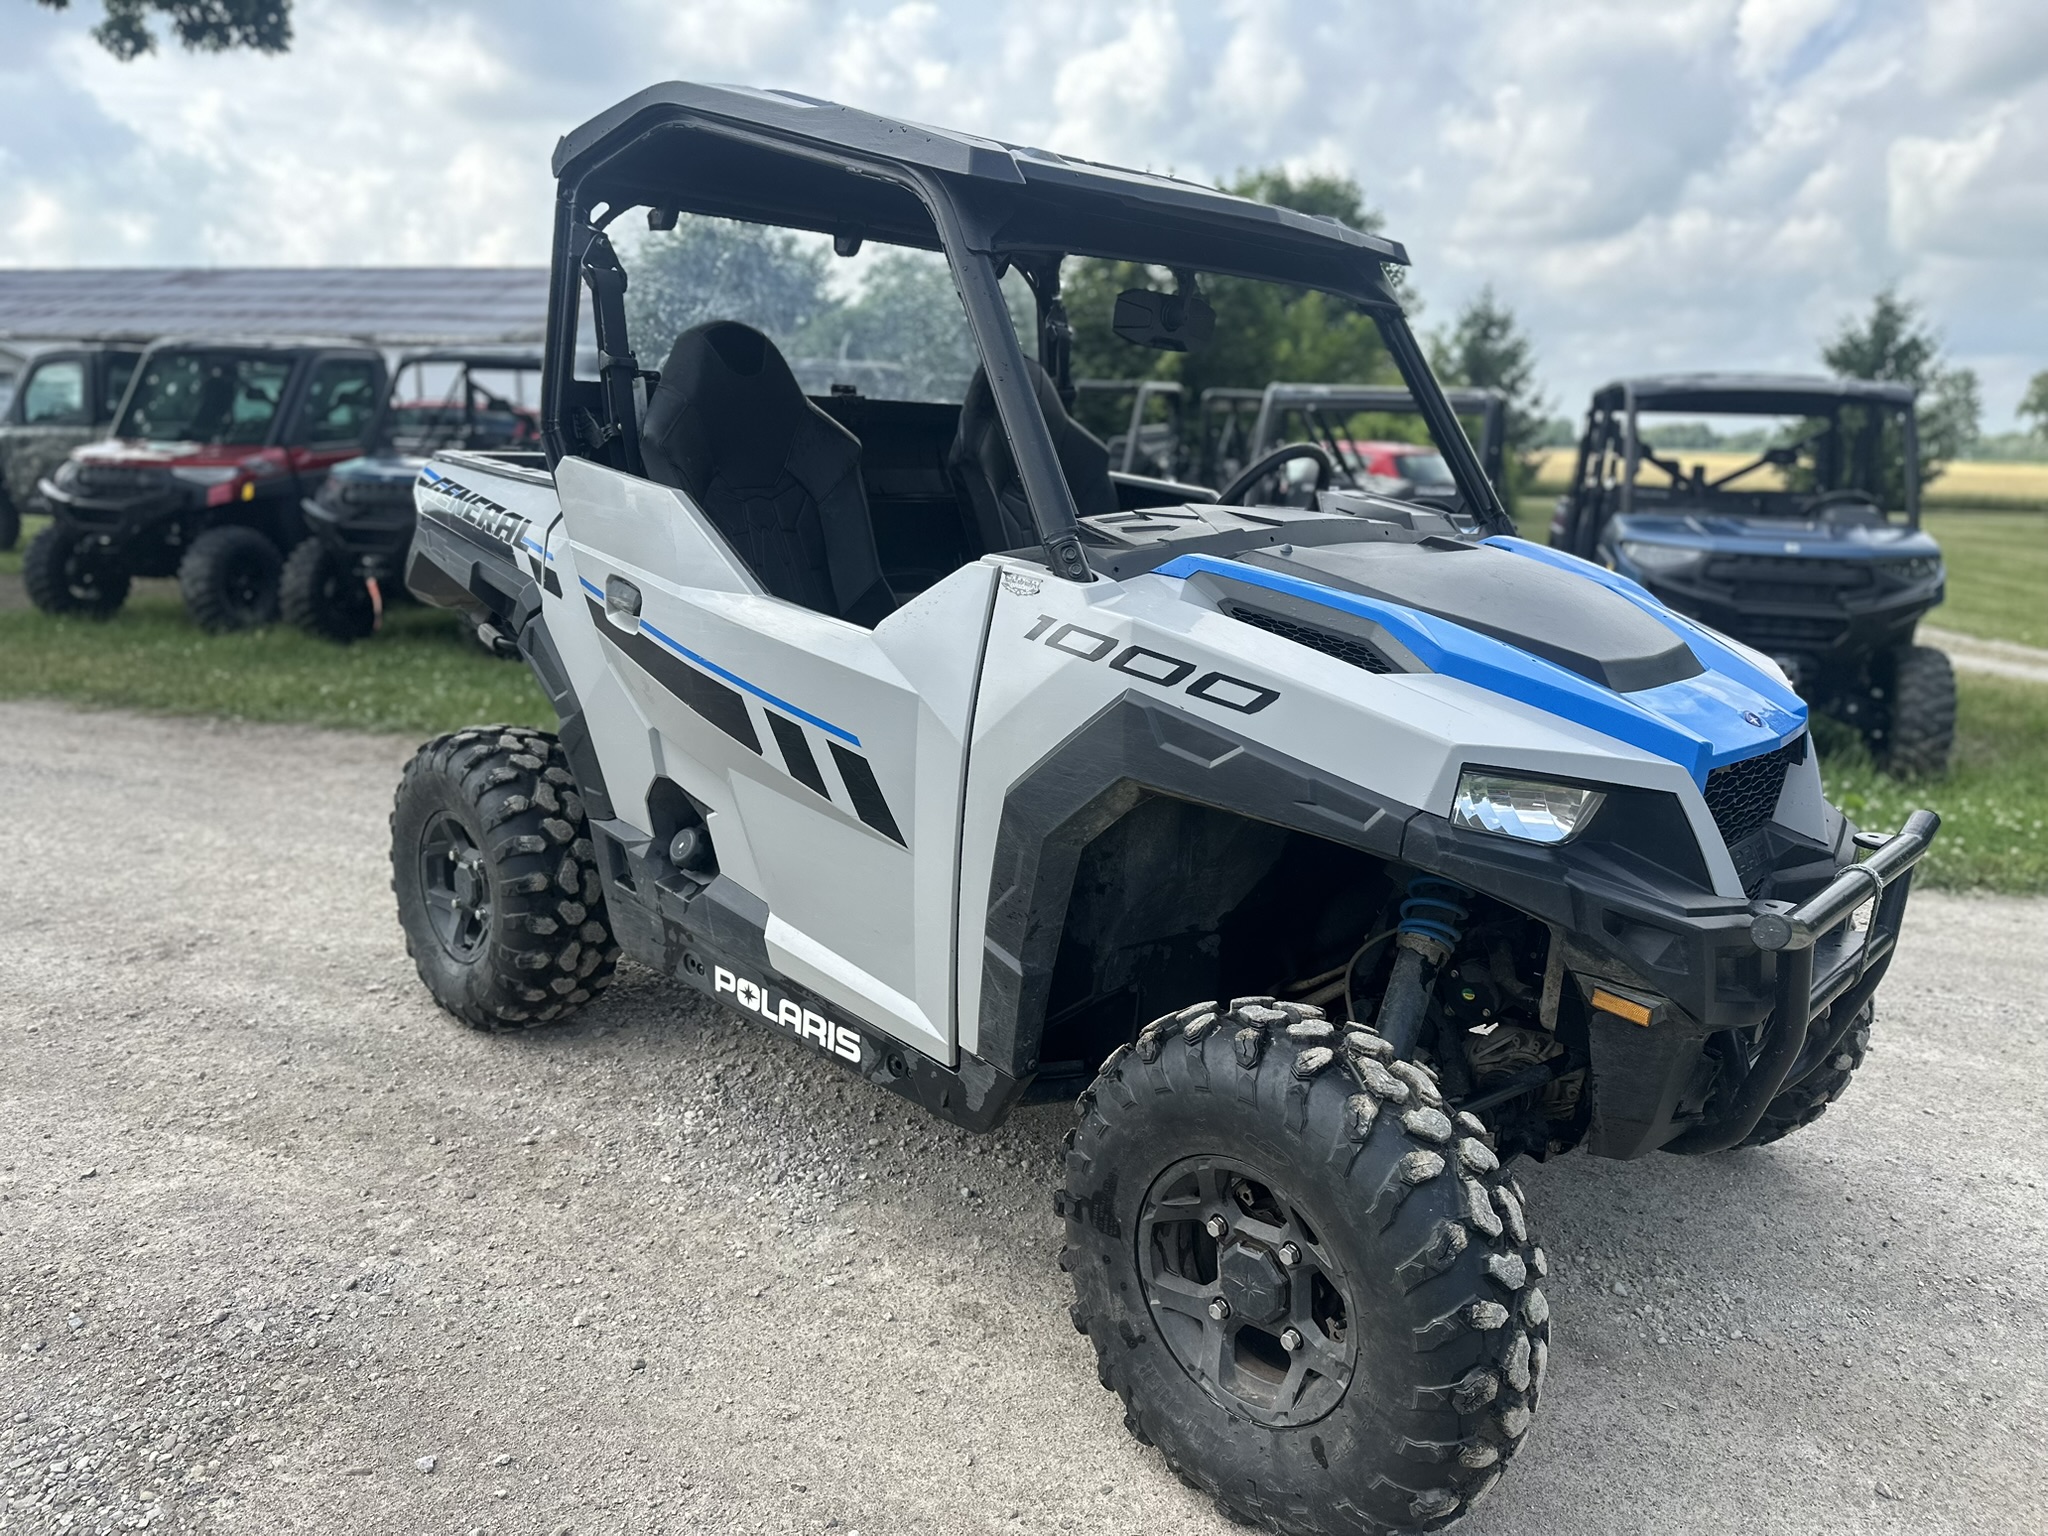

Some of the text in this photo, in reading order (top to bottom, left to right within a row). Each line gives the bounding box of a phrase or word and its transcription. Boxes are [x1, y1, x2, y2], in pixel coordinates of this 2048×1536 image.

[422, 477, 532, 553] GENERAL
[1023, 613, 1281, 715] 1000
[714, 965, 861, 1063] POLARIS
